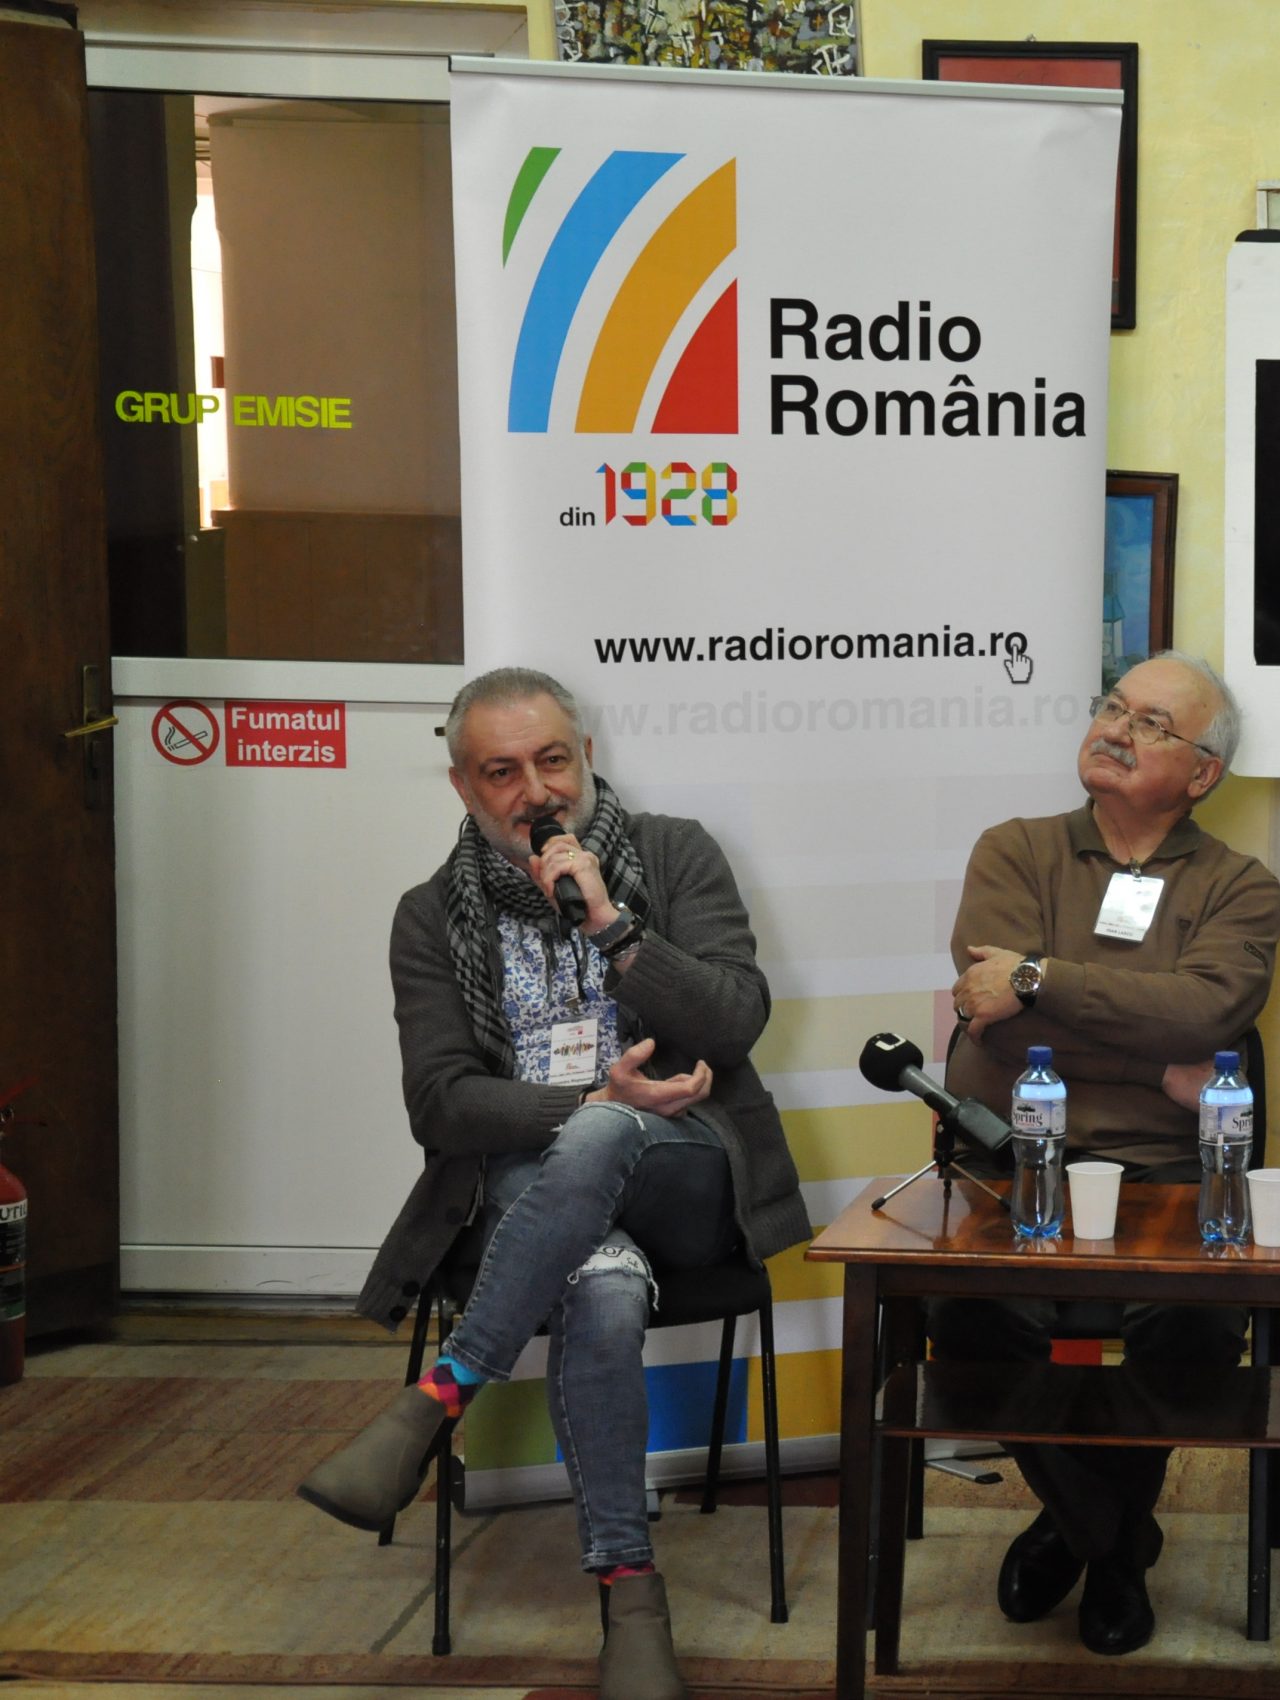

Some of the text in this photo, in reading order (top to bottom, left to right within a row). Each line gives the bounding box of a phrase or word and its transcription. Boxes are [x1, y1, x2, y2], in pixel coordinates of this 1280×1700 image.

[769, 297, 982, 363] Radio
[115, 390, 353, 429] GRUP EMISIE
[770, 374, 1087, 438] România
[559, 462, 738, 526] din 1928
[594, 624, 1028, 663] www.radioromania.ro
[231, 707, 341, 731] Fumatul
[585, 685, 1081, 738] w.radioromania.ro
[237, 740, 336, 763] interzis
